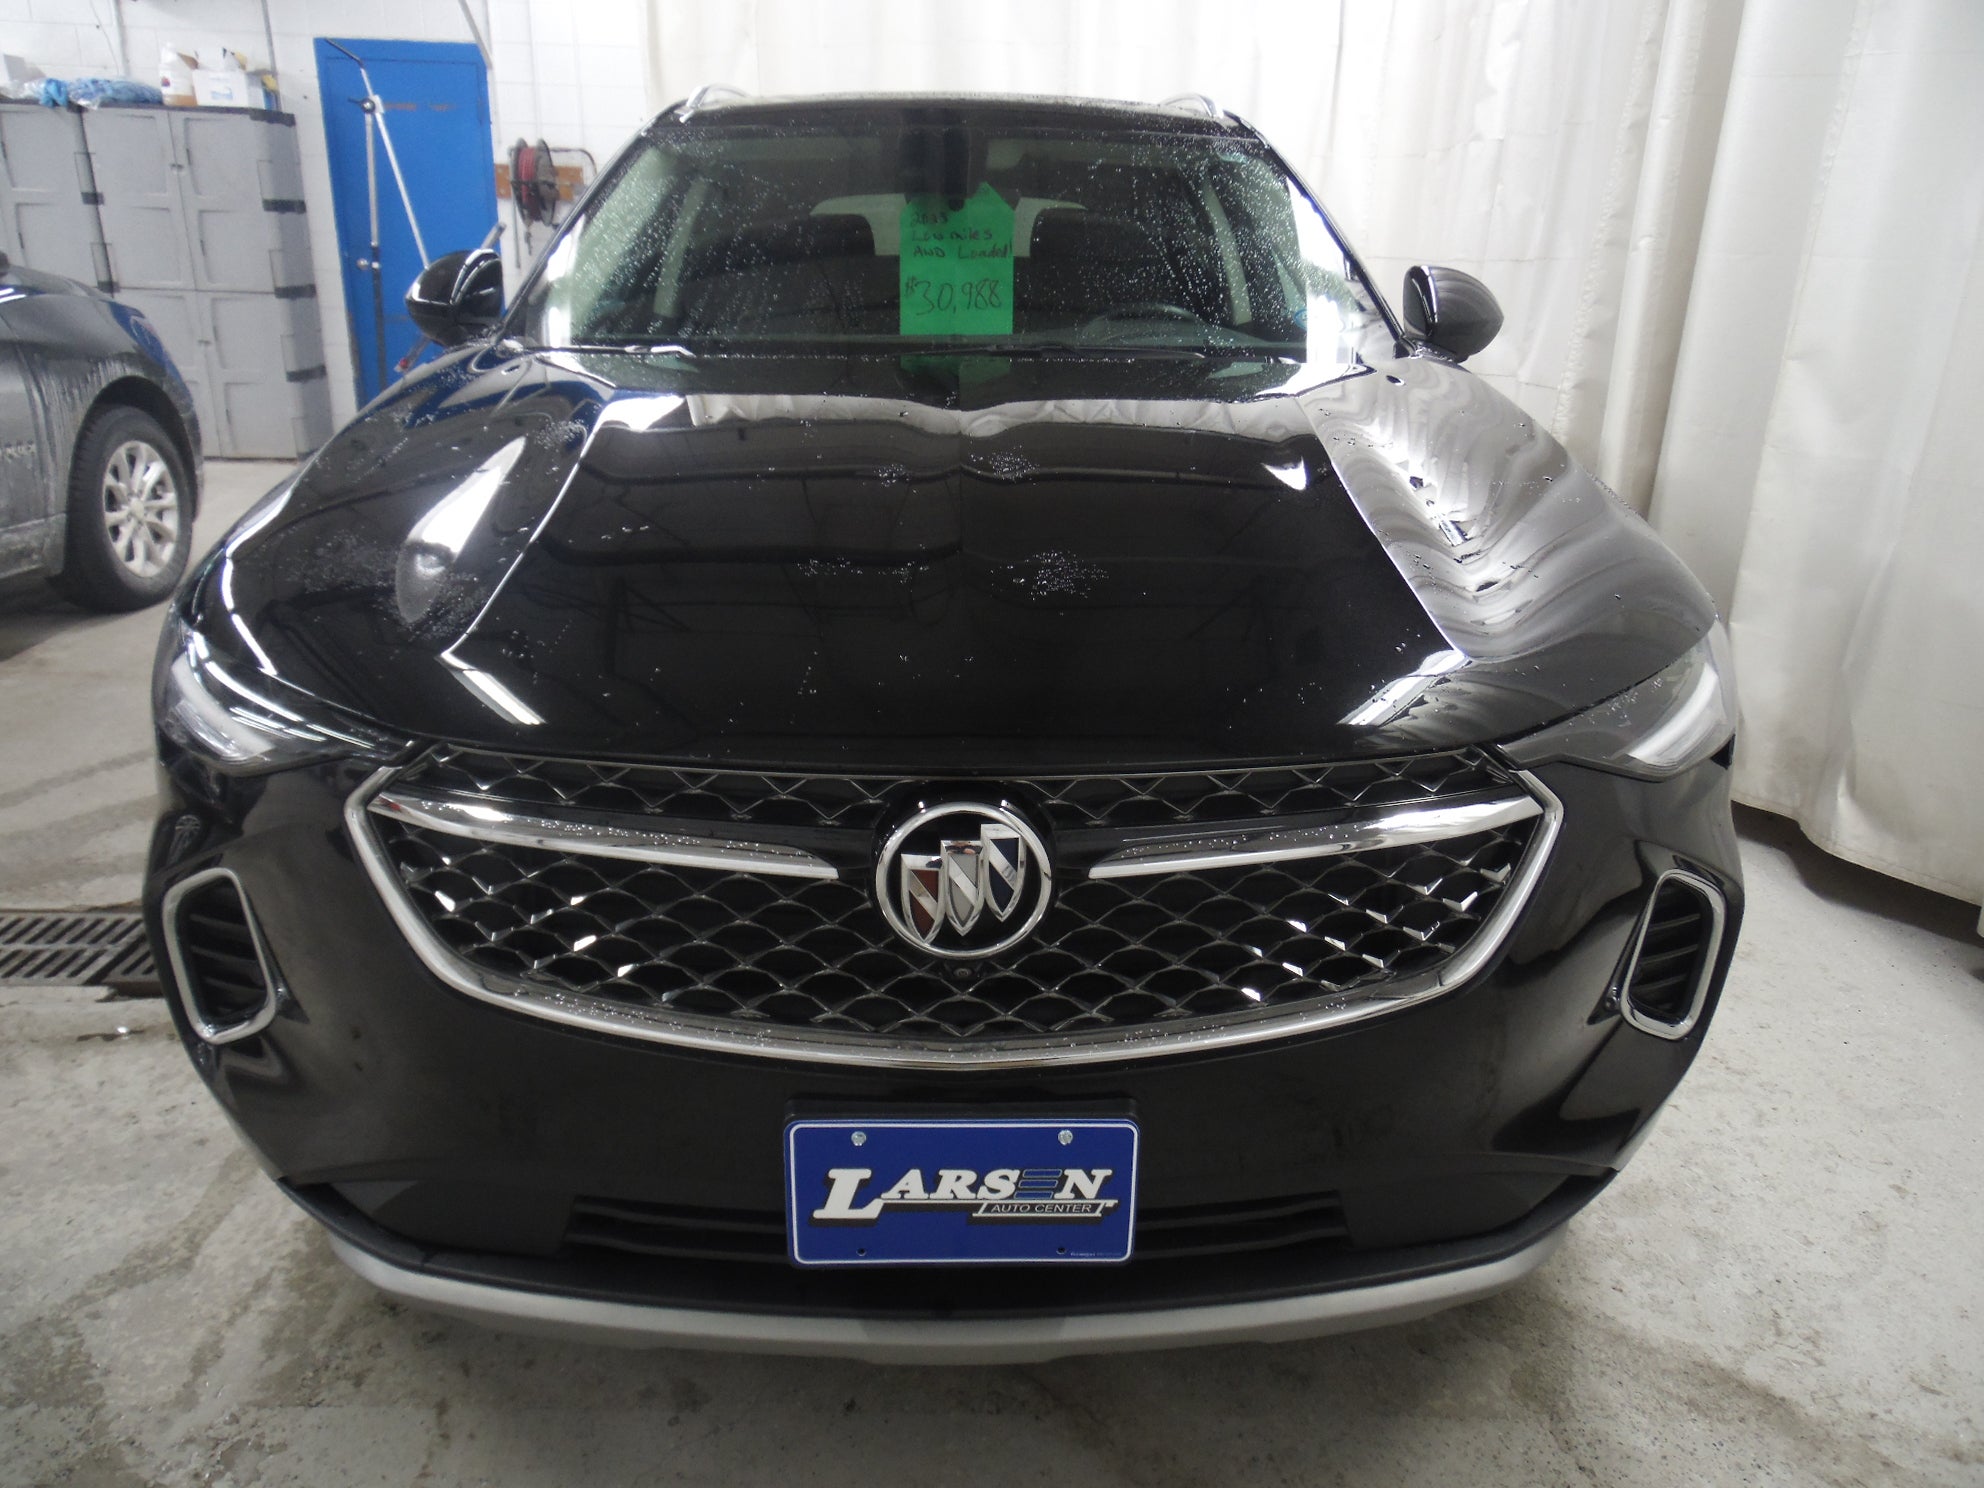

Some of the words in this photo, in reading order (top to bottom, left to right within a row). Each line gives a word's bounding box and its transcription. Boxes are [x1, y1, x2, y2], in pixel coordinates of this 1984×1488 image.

[906, 276, 1002, 316] $30,988
[811, 1167, 1115, 1220] LARSEN
[990, 1203, 1030, 1214] AUTO
[1034, 1203, 1093, 1214] CENTER
